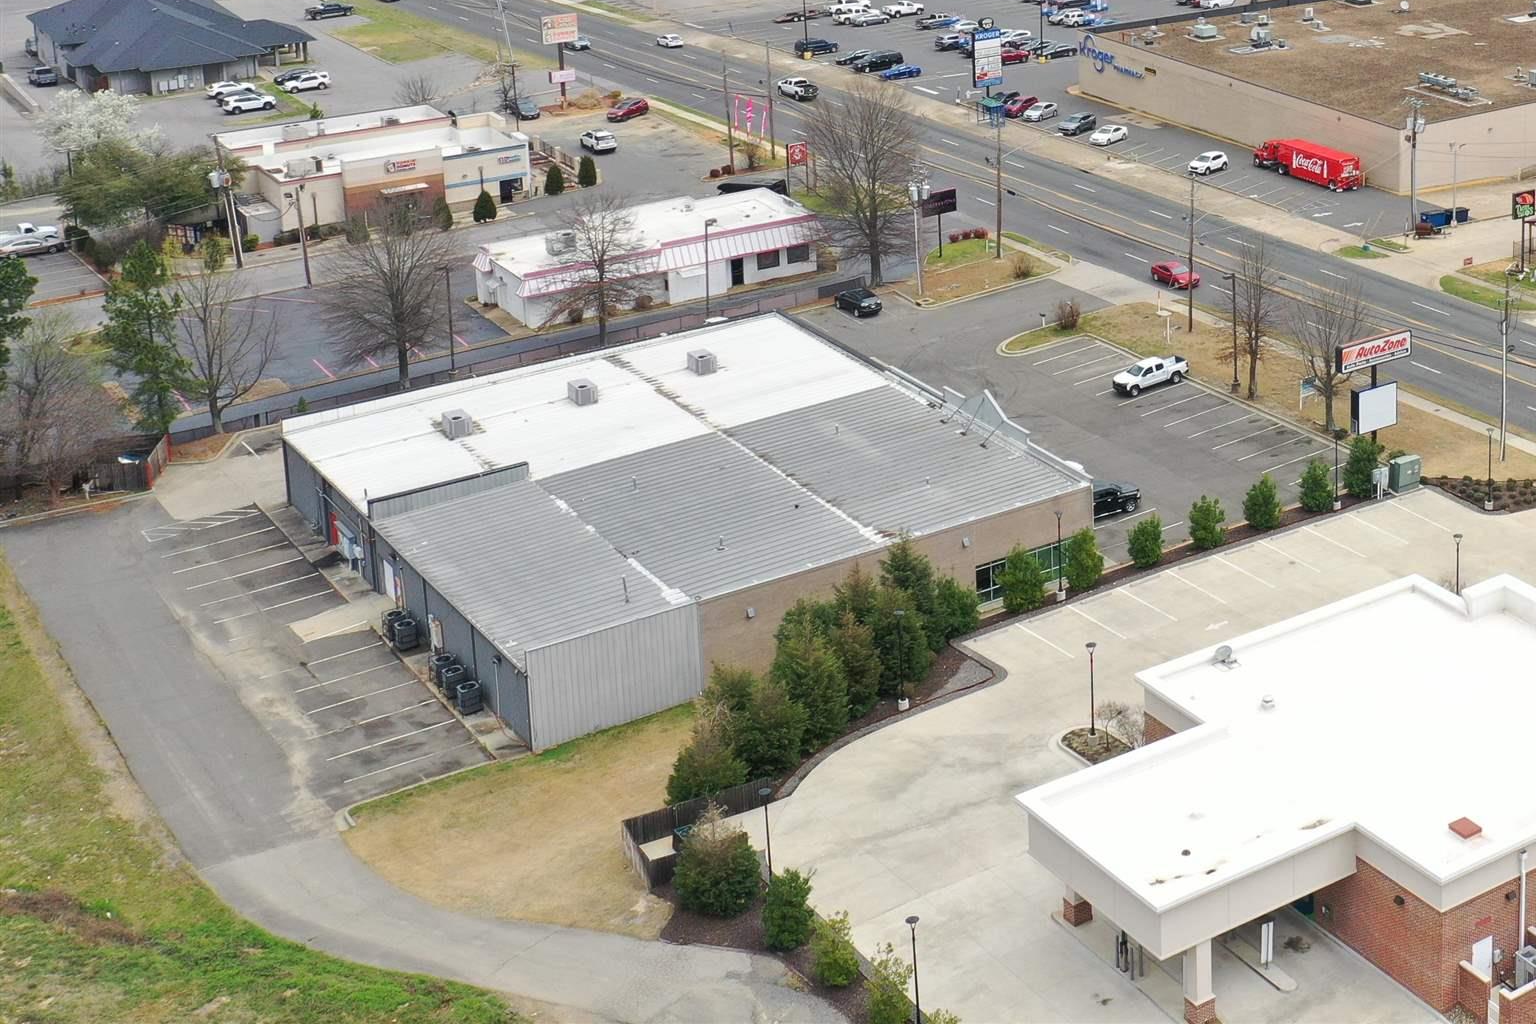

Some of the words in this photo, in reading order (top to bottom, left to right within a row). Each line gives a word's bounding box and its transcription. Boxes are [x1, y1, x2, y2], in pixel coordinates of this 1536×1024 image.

[975, 31, 1000, 40] KROGER
[1079, 34, 1114, 73] Kroger
[1355, 337, 1407, 359] AutoZone
